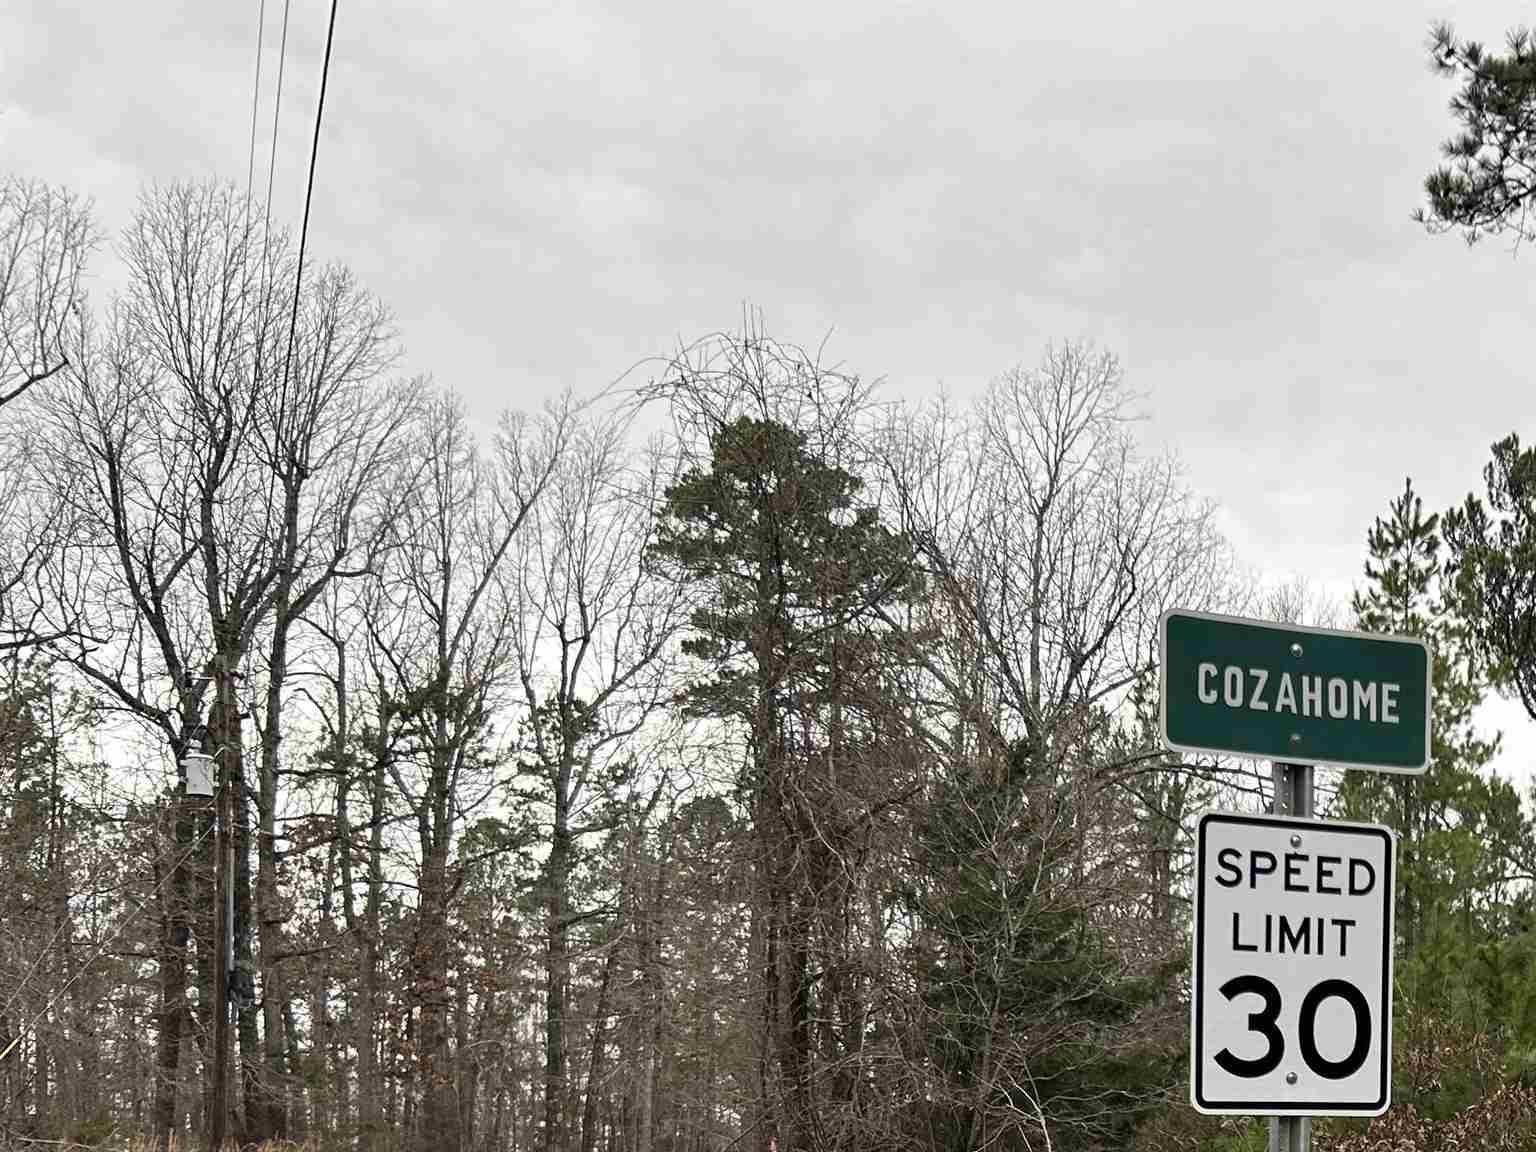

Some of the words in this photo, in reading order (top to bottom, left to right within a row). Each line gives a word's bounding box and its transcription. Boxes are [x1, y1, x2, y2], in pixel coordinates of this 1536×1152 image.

[1197, 663, 1401, 724] COZAHOME
[1215, 848, 1376, 896] SPEED
[1233, 913, 1356, 957] LIMIT
[1213, 975, 1372, 1080] 30
